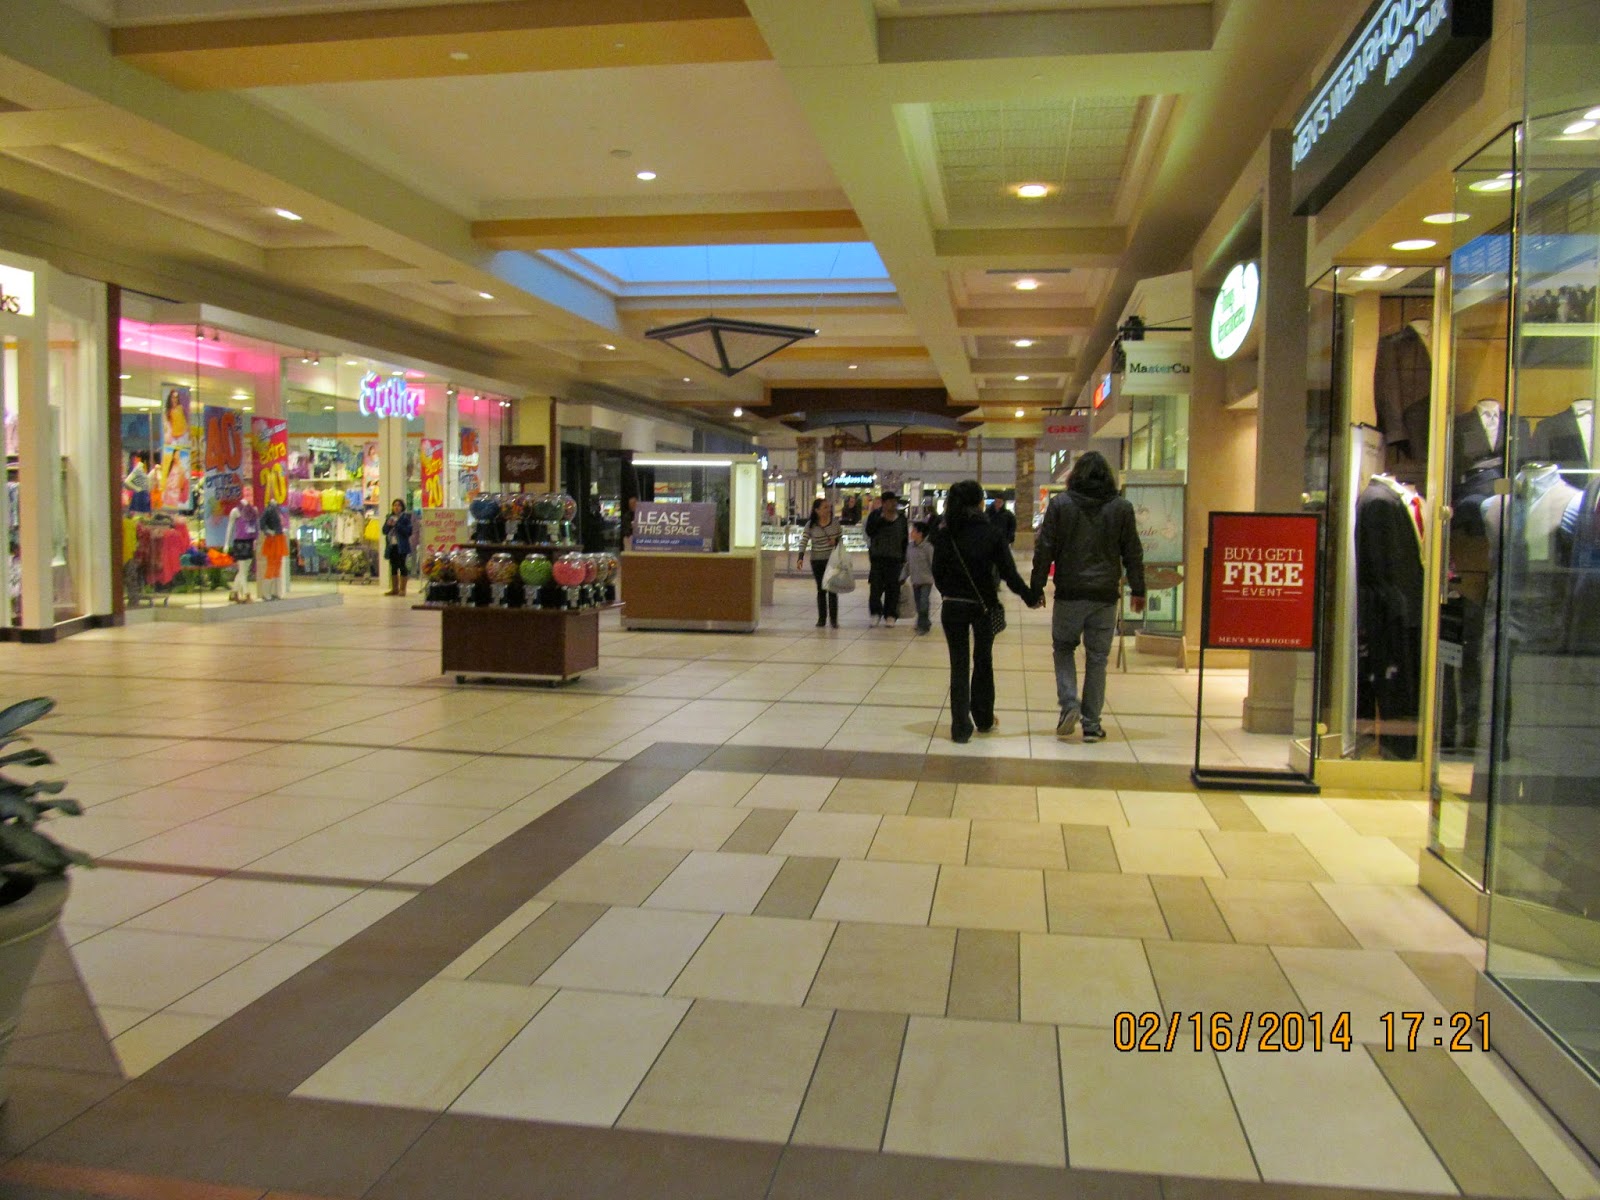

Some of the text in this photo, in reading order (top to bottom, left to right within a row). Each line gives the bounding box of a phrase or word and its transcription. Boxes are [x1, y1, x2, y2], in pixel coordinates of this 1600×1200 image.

[1384, 33, 1414, 86] AND
[1047, 424, 1086, 435] GNC
[638, 511, 690, 526] LEASE
[638, 525, 700, 536] THIS SPACE
[1224, 547, 1255, 560] BUY
[1265, 548, 1296, 561] GET
[1222, 561, 1304, 587] FREE
[1242, 587, 1283, 597] EVENT
[1219, 635, 1302, 645] MEN'S WEARHOUSE
